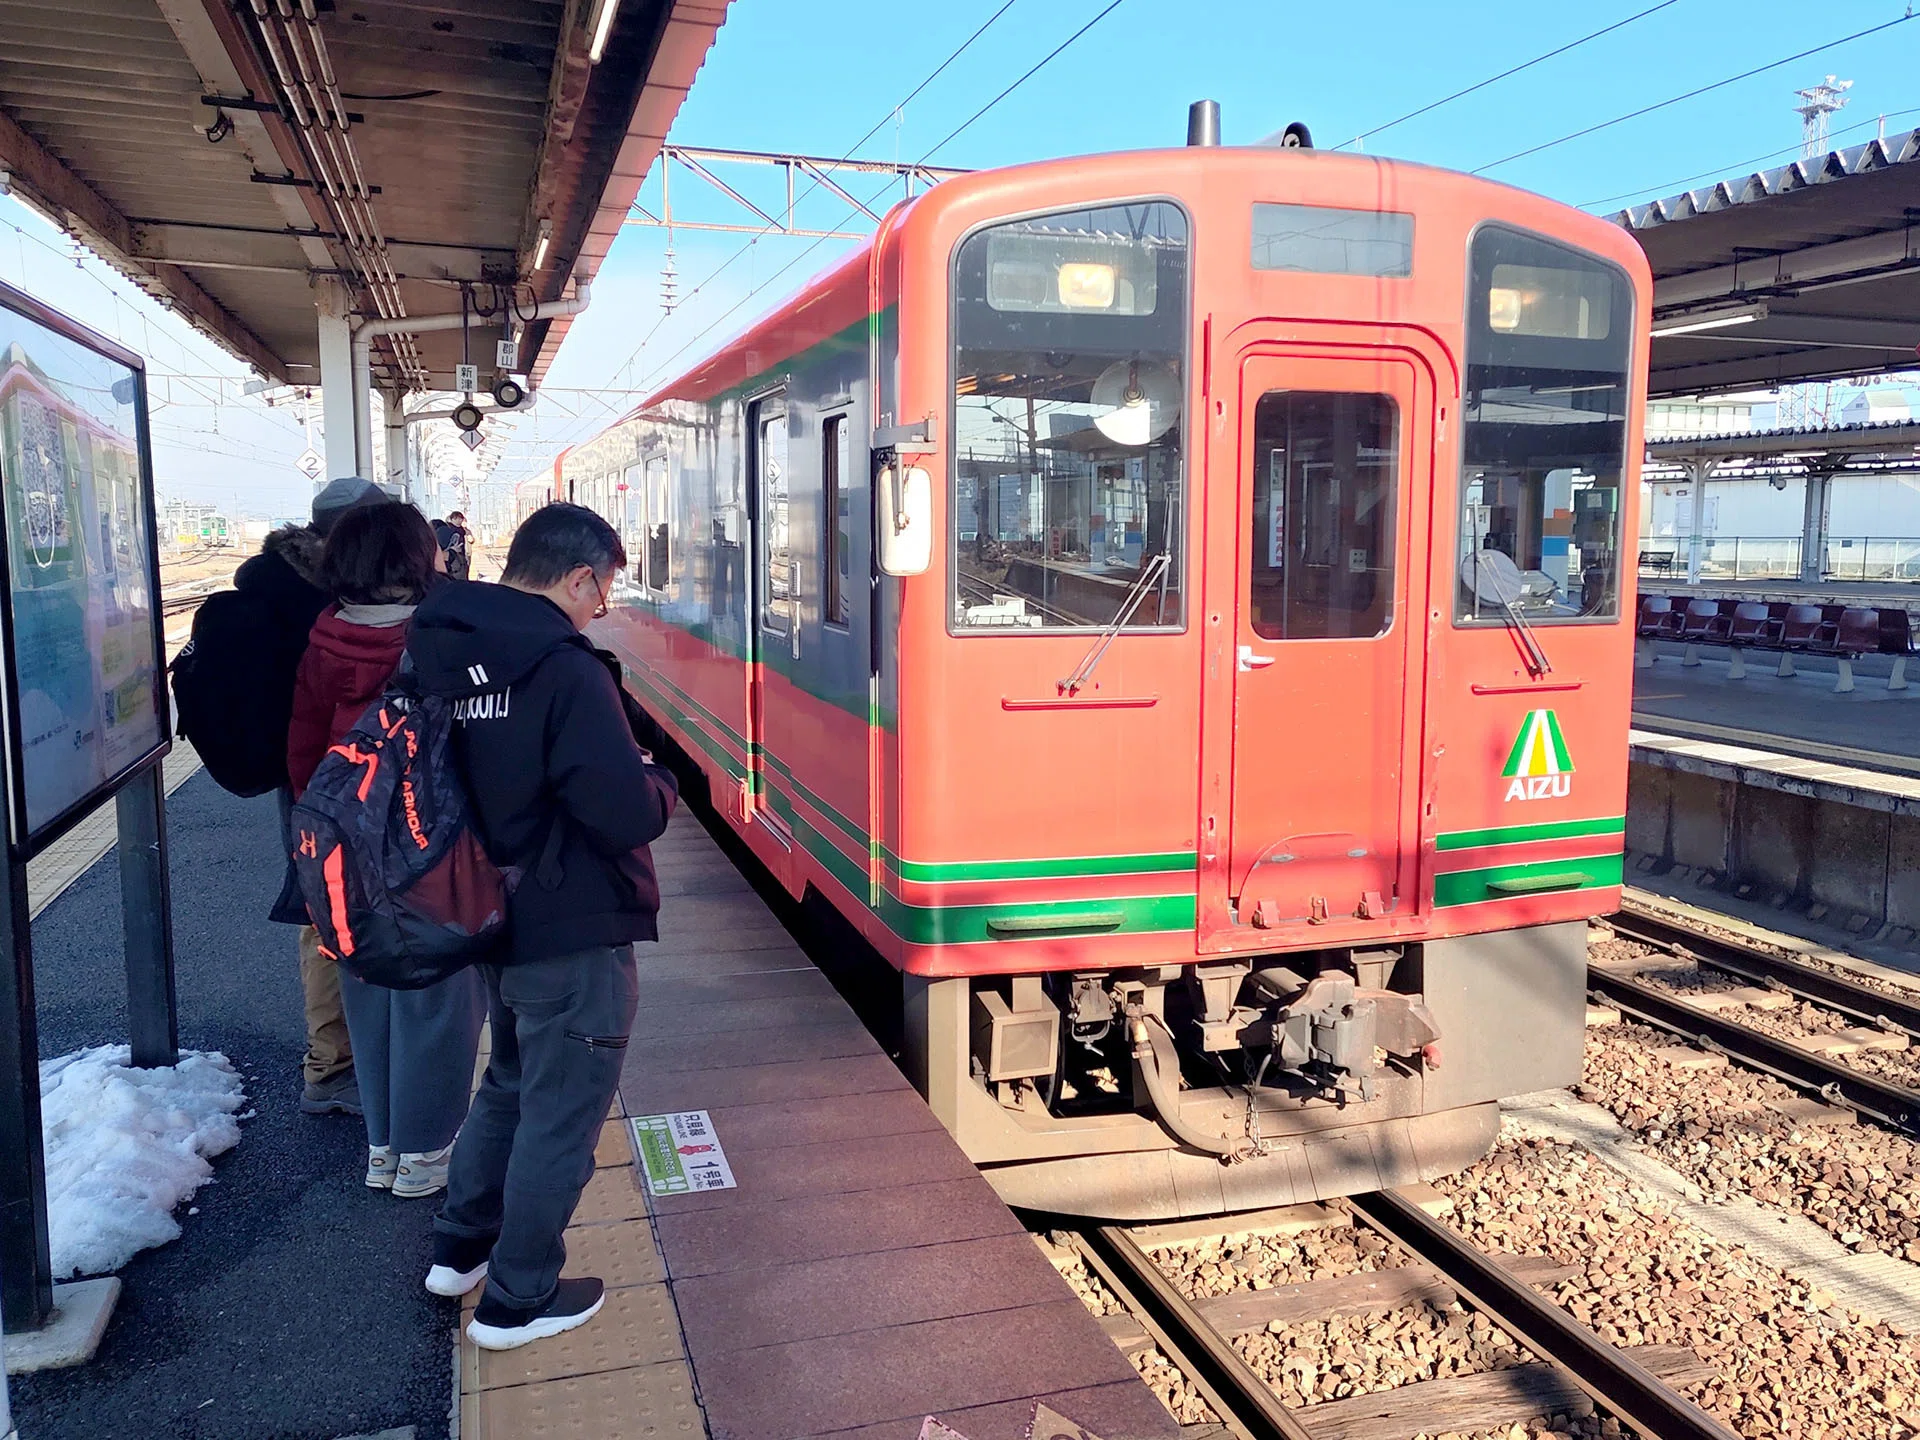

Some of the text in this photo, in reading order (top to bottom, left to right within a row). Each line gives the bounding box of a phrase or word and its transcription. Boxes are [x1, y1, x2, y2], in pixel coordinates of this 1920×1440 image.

[501, 343, 513, 367] 郡山
[461, 366, 473, 390] 新津
[305, 456, 318, 471] 2
[1504, 774, 1571, 802] AIZU
[402, 781, 429, 850] ARMOUR
[684, 1114, 706, 1137] 只見線
